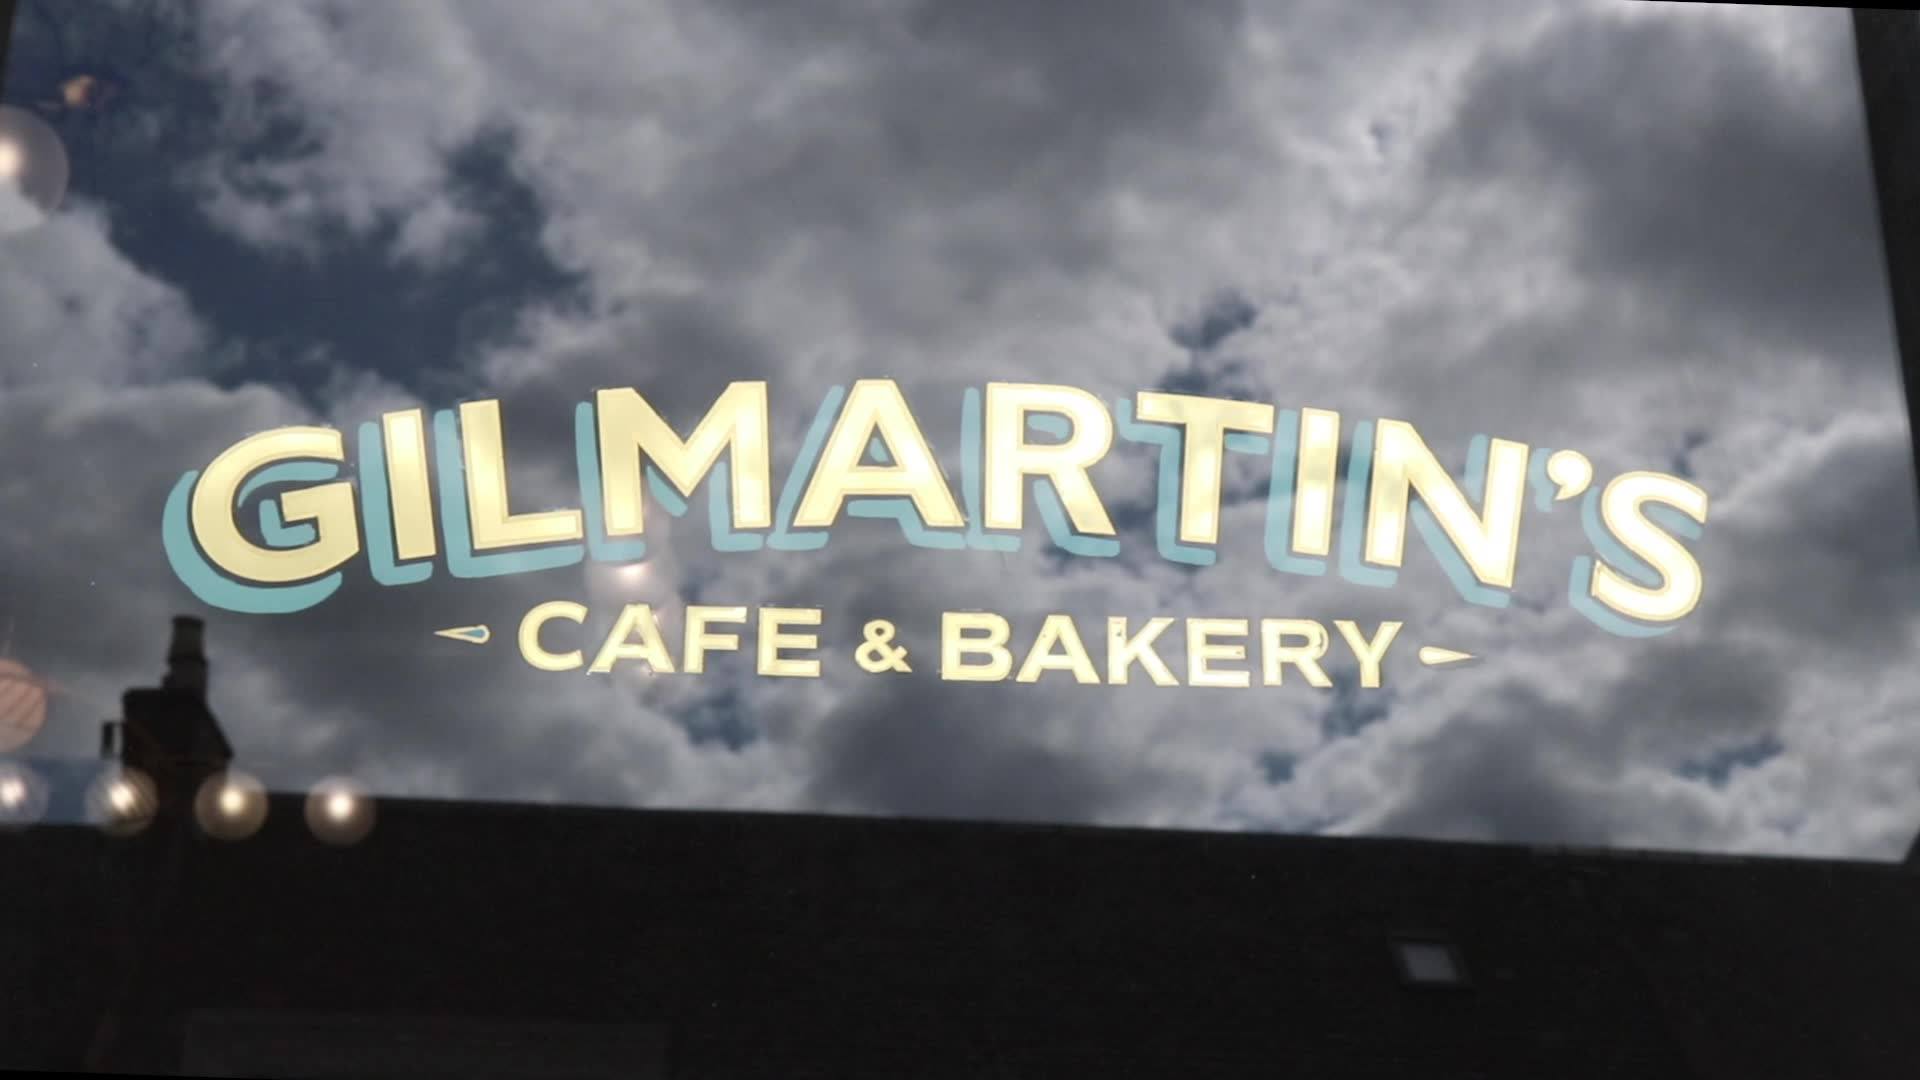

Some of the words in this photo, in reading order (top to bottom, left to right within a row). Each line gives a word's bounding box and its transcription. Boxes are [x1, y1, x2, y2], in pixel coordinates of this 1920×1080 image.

[190, 378, 1708, 623] GILMARTIN’S
[518, 600, 822, 677] CAFE
[855, 619, 912, 673] &
[941, 611, 1403, 689] BAKERY
